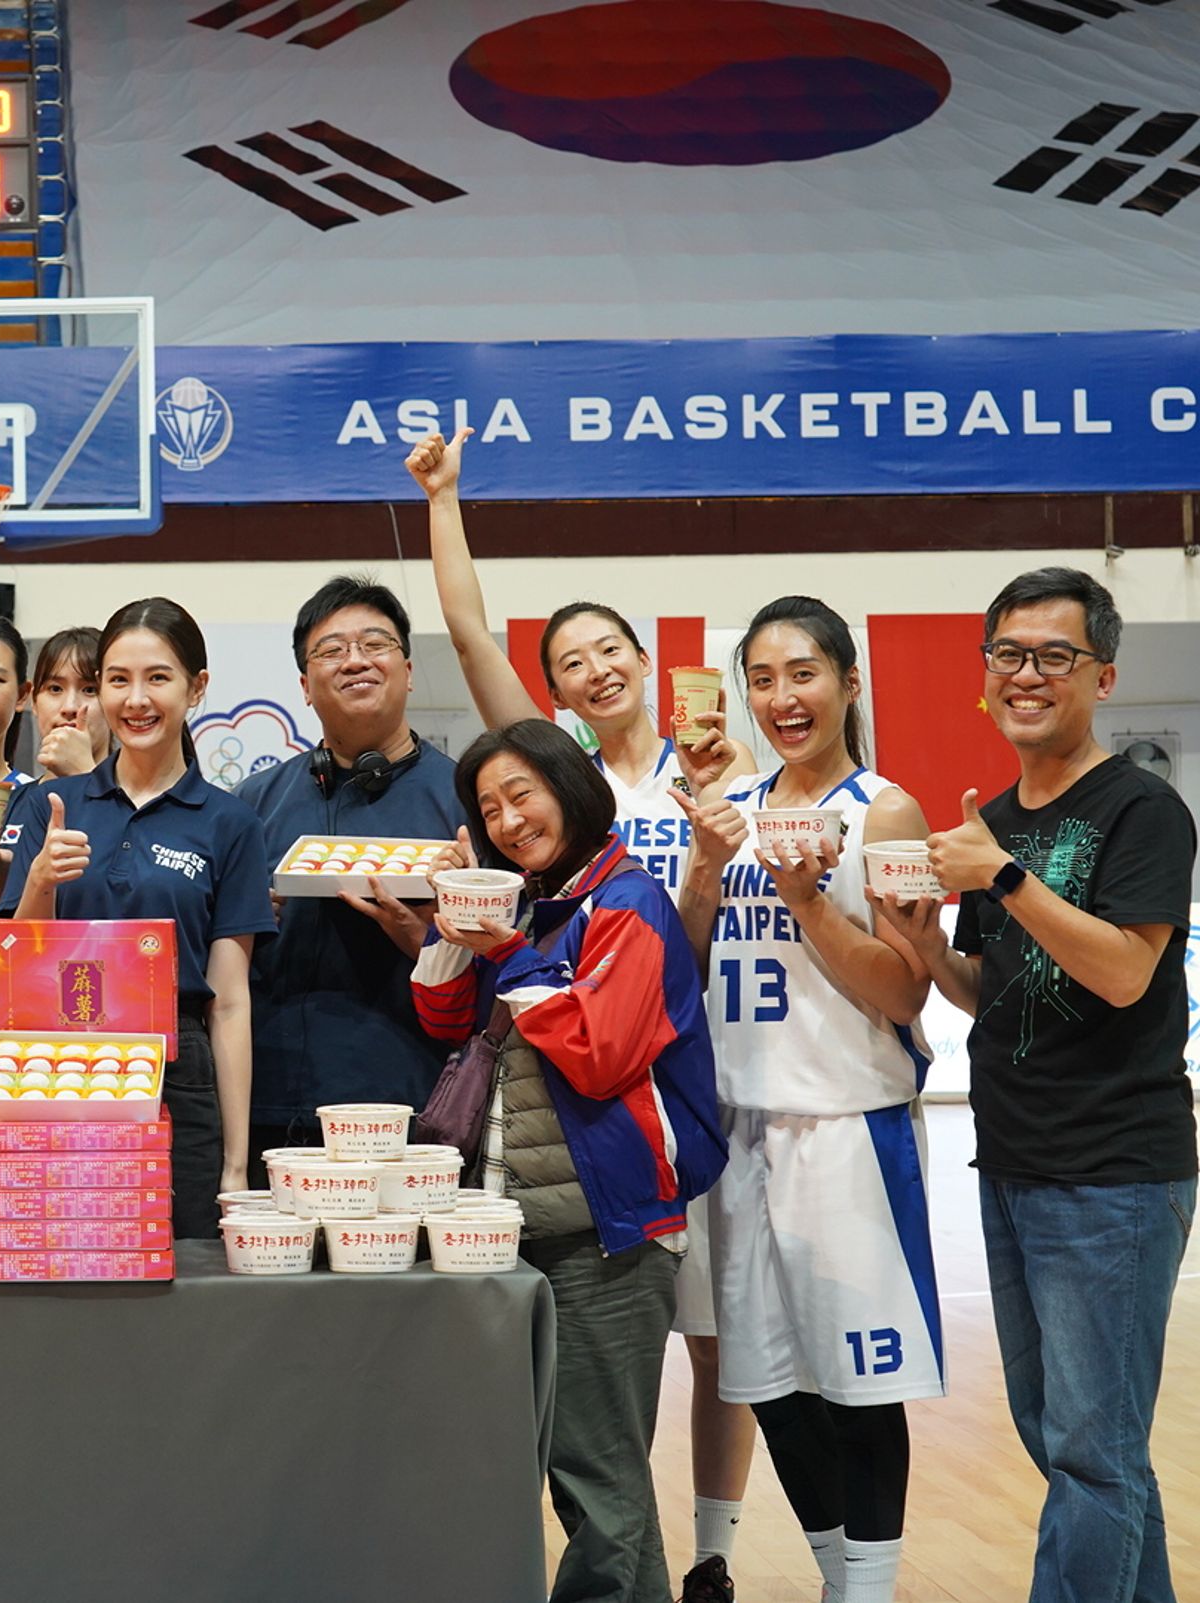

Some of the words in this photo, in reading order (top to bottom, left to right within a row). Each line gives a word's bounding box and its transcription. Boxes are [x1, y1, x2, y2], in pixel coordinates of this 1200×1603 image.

[336, 398, 532, 445] ASIA
[569, 389, 1113, 442] BASKETBALL
[151, 843, 206, 873] CHINESE
[155, 854, 196, 880] TAIPEI
[720, 958, 789, 1023] 13
[845, 1326, 904, 1377] 13
